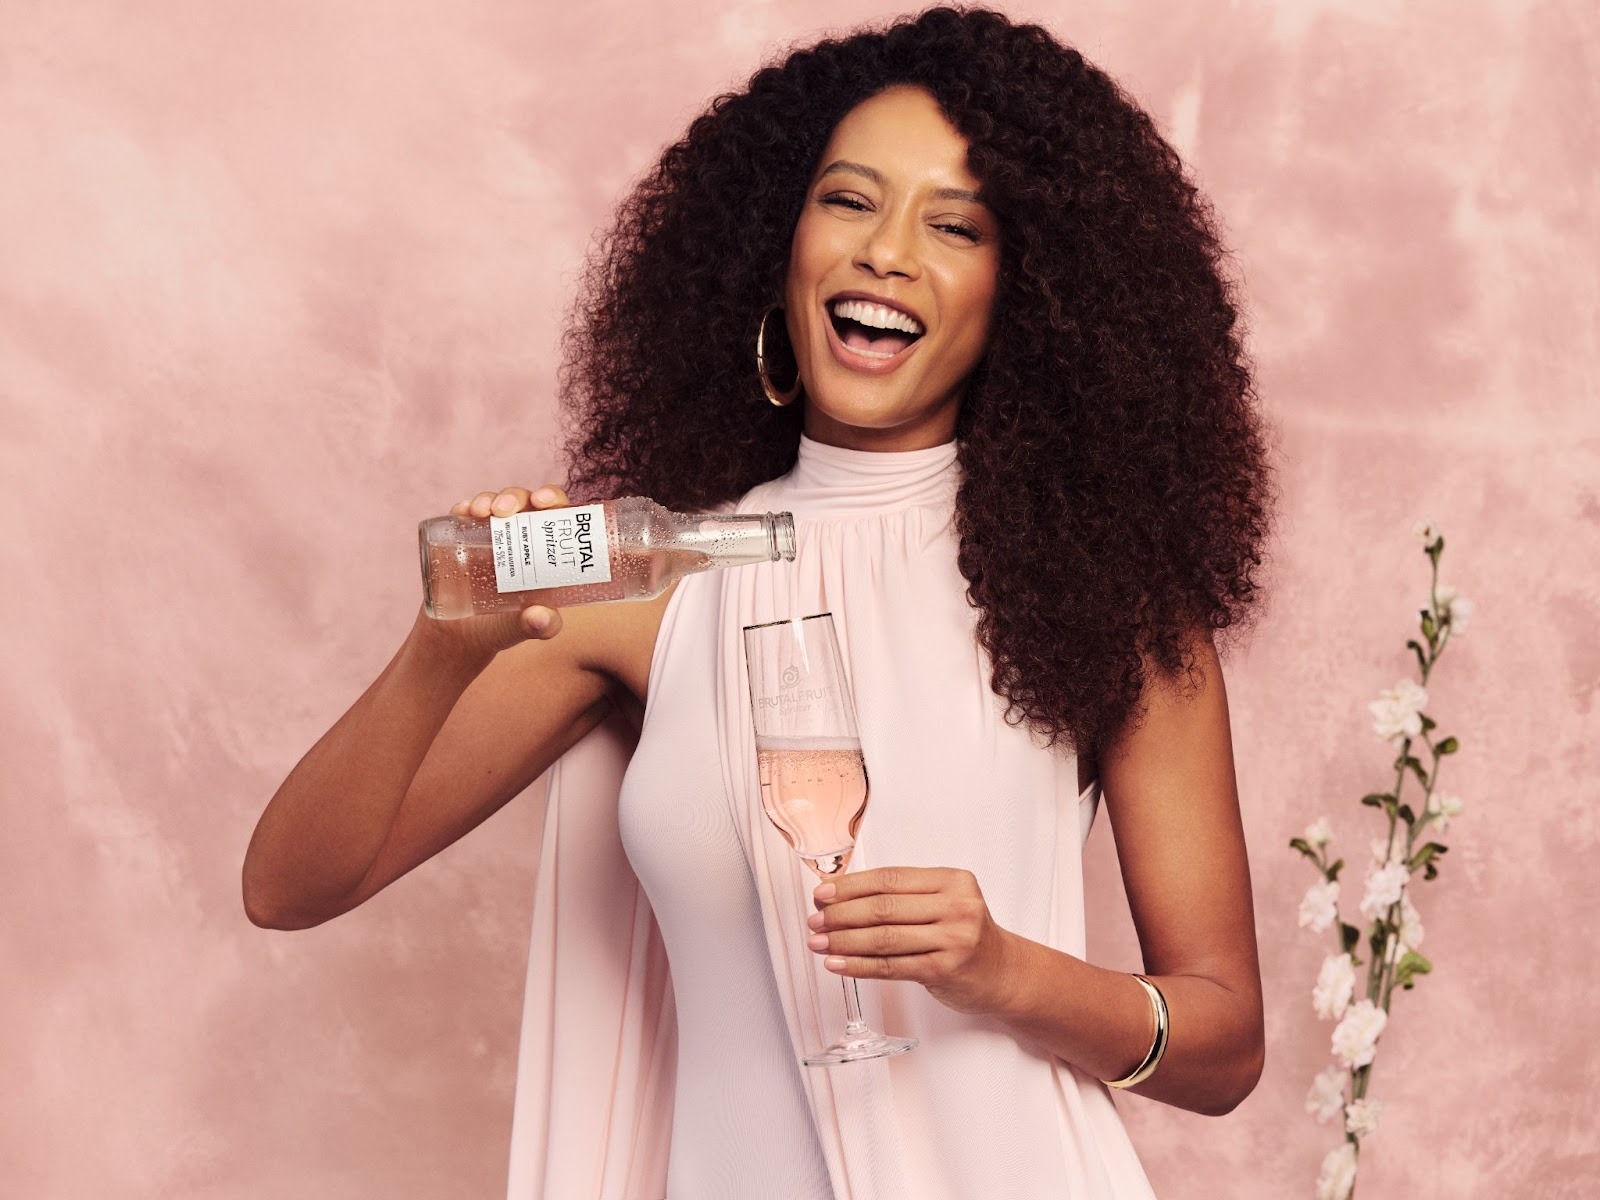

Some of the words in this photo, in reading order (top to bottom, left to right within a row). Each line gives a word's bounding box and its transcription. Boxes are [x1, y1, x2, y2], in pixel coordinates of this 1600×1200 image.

[523, 544, 531, 566] APPLE
[541, 520, 557, 567] Spritzer
[558, 519, 576, 567] FRUIT
[575, 513, 594, 573] BRUTAL
